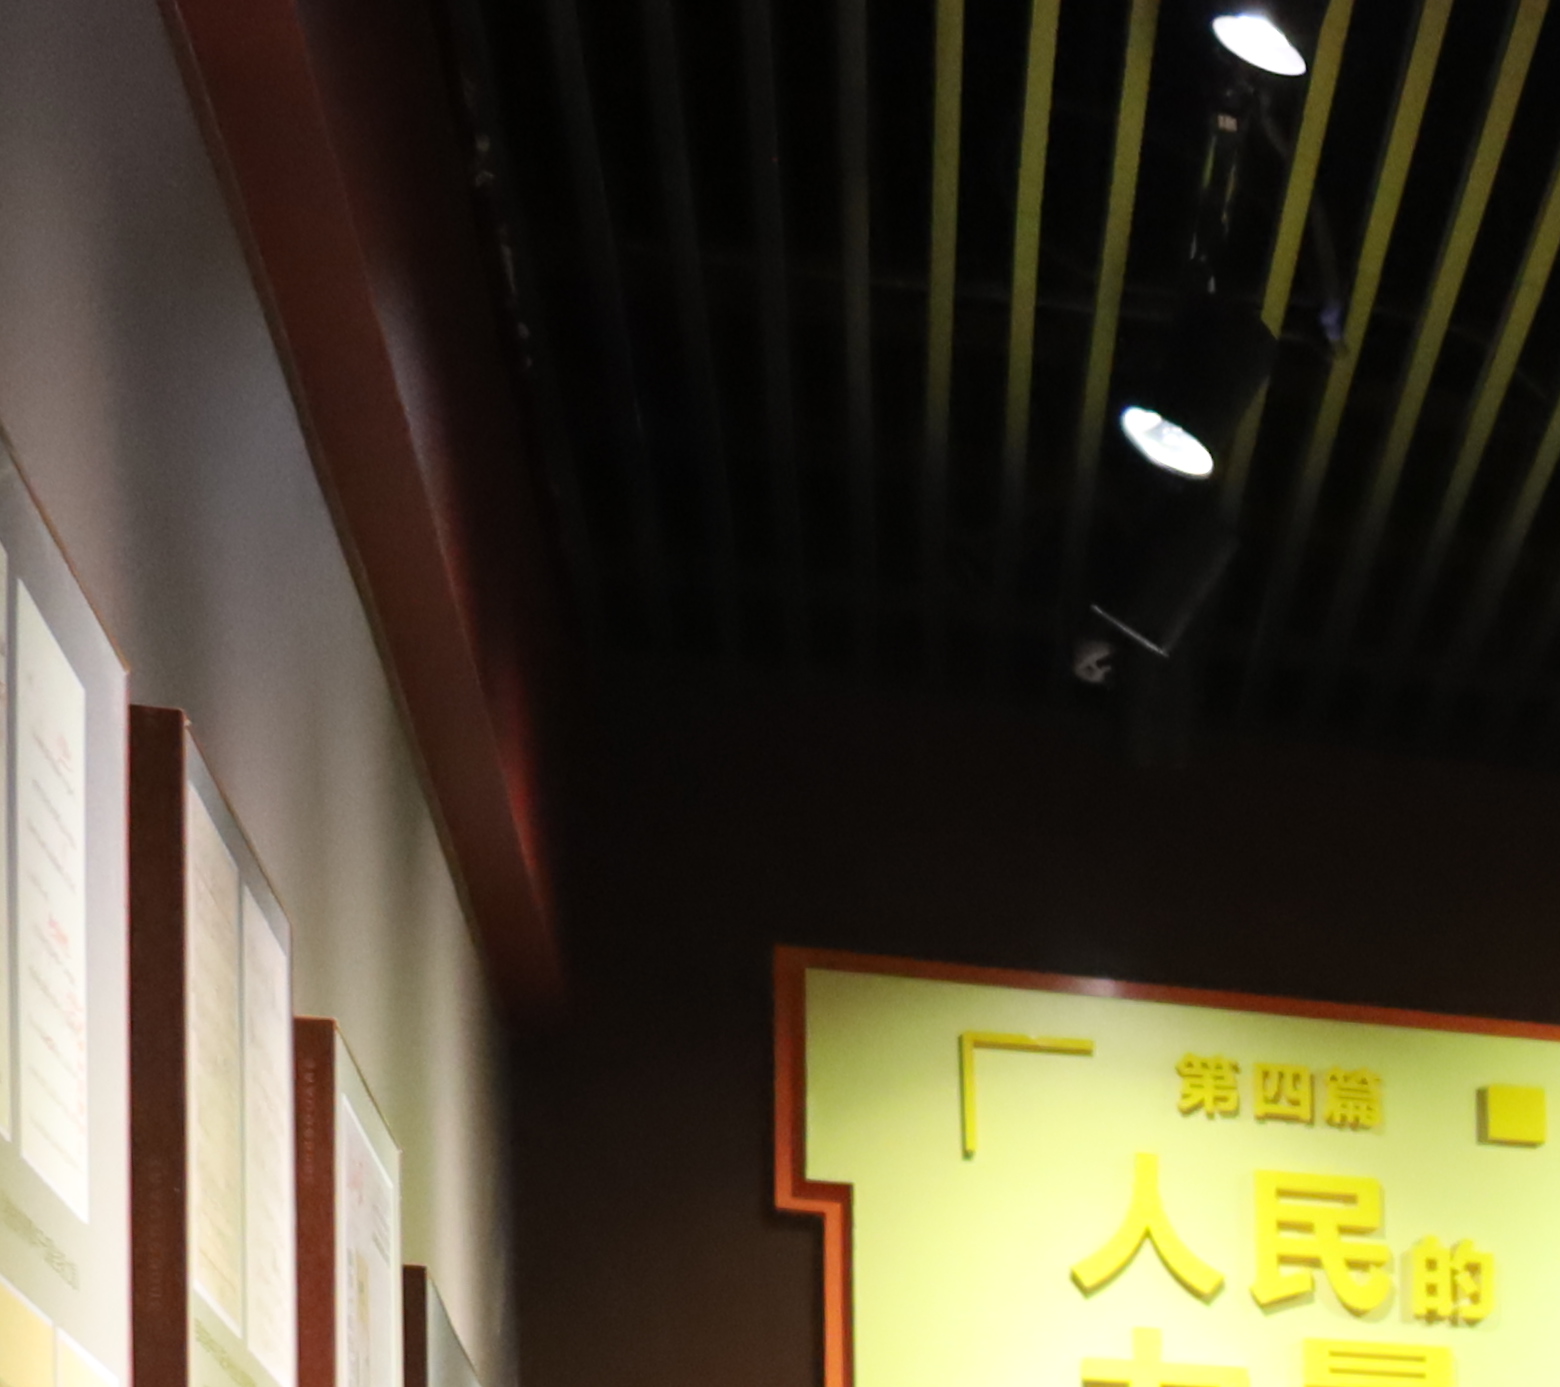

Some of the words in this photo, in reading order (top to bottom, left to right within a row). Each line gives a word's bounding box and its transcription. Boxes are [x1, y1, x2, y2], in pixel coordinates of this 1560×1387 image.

[1175, 1053, 1385, 1129] 第四篇
[1071, 1152, 1496, 1323] 人民的
